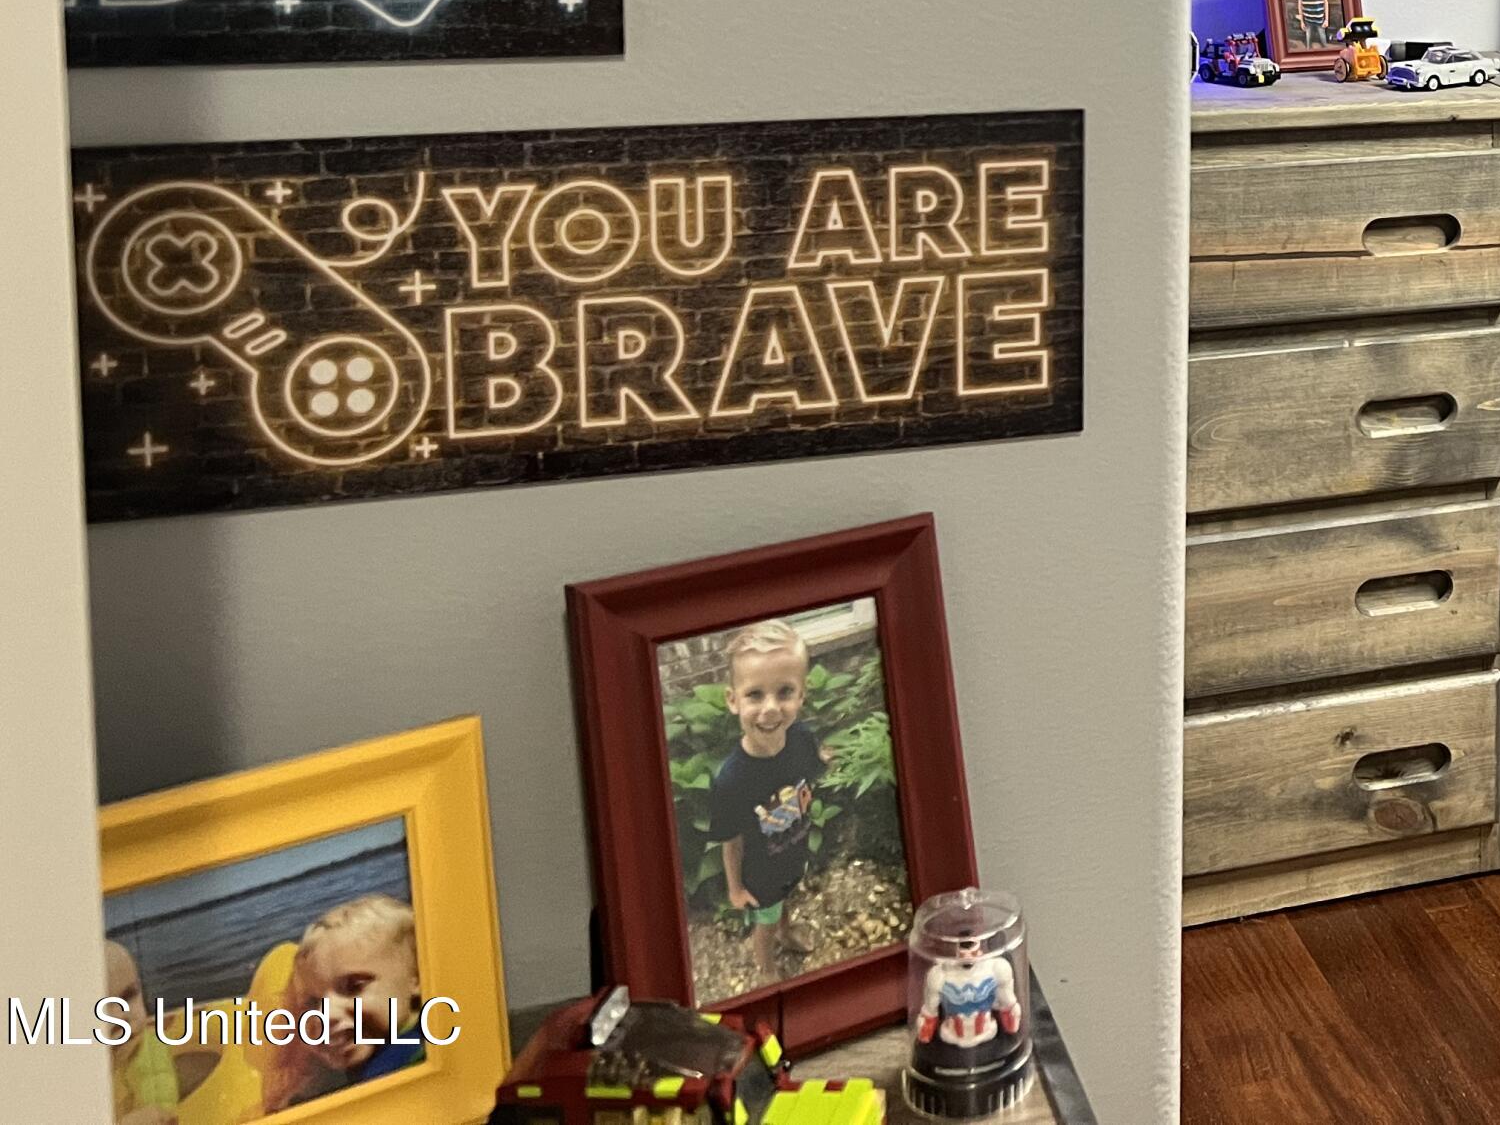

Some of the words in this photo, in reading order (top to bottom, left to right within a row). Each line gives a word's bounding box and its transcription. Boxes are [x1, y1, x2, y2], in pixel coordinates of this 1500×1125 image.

[442, 175, 733, 290] YOU
[787, 160, 1050, 270] ARE
[444, 269, 1050, 440] BRAVE
